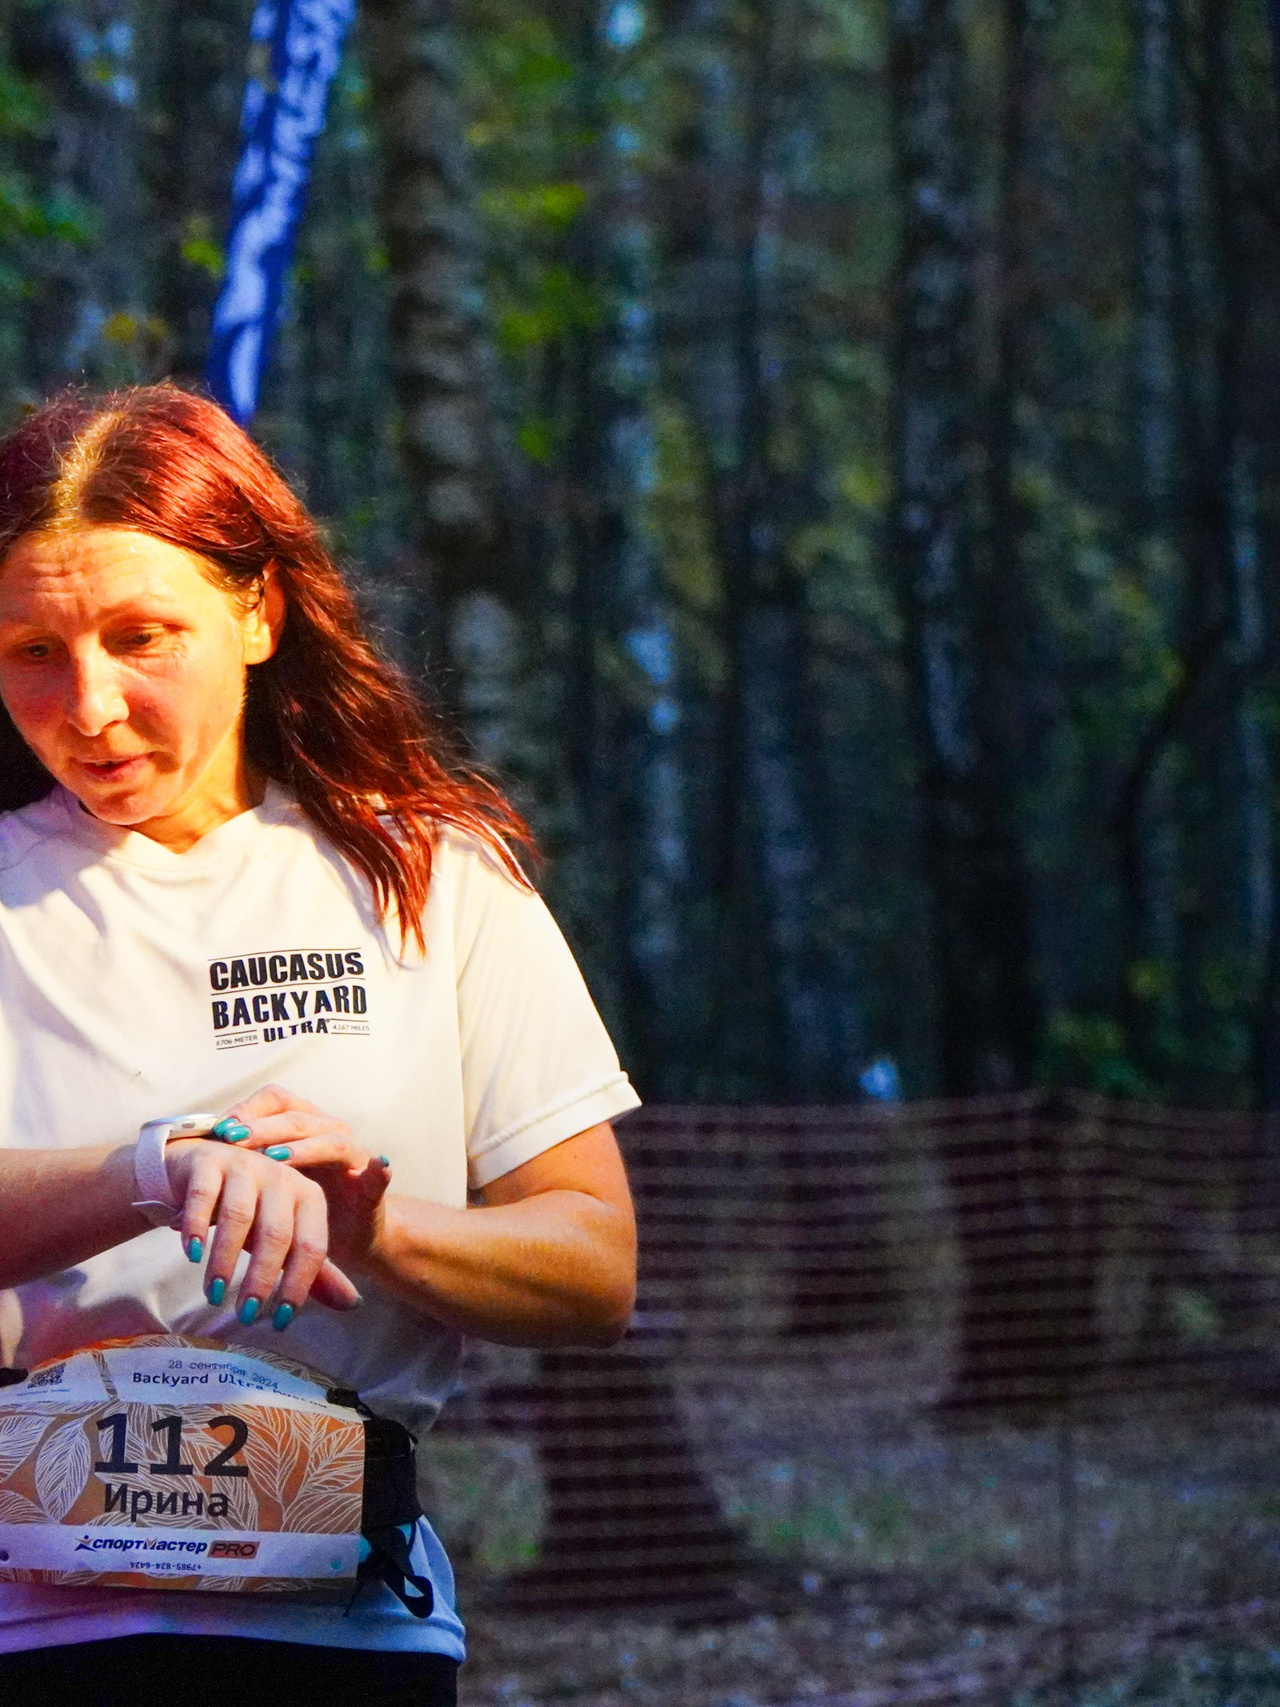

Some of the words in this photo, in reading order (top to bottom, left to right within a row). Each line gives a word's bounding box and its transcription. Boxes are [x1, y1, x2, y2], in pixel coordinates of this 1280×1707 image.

[210, 952, 364, 991] CAUCASUS
[211, 985, 368, 1030] BACKYARD
[234, 1035, 258, 1044] METER
[133, 1373, 209, 1387] Backyard
[218, 1374, 264, 1390] Ultra
[168, 1360, 182, 1369] 28
[189, 1362, 246, 1377] сентября
[252, 1373, 278, 1389] 2024
[94, 1413, 249, 1477] 112
[104, 1483, 229, 1523] Ирина
[211, 1542, 256, 1557] PRO
